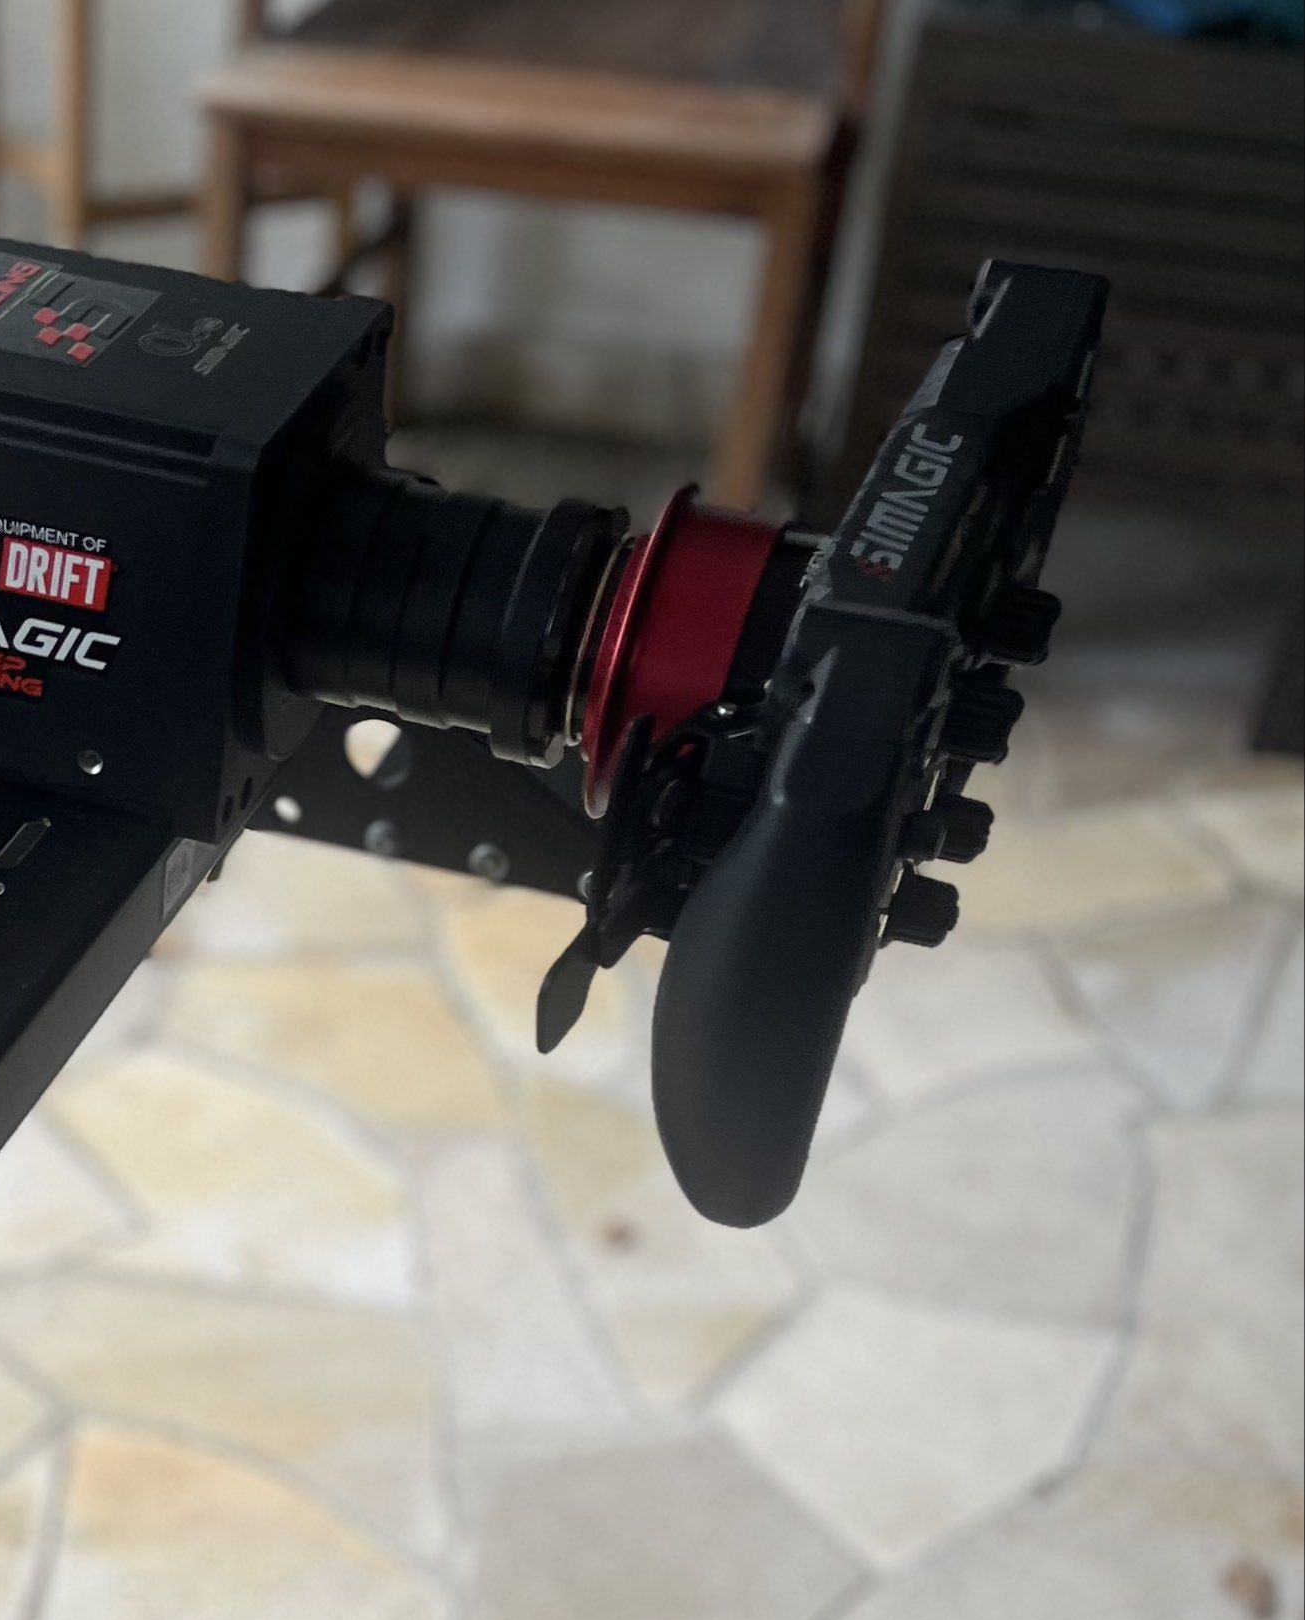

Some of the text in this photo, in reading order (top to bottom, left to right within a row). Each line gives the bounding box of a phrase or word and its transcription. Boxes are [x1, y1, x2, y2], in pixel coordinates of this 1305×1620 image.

[849, 422, 964, 570] SIMAGIC
[5, 542, 105, 605] DRIFT
[82, 536, 107, 552] OF
